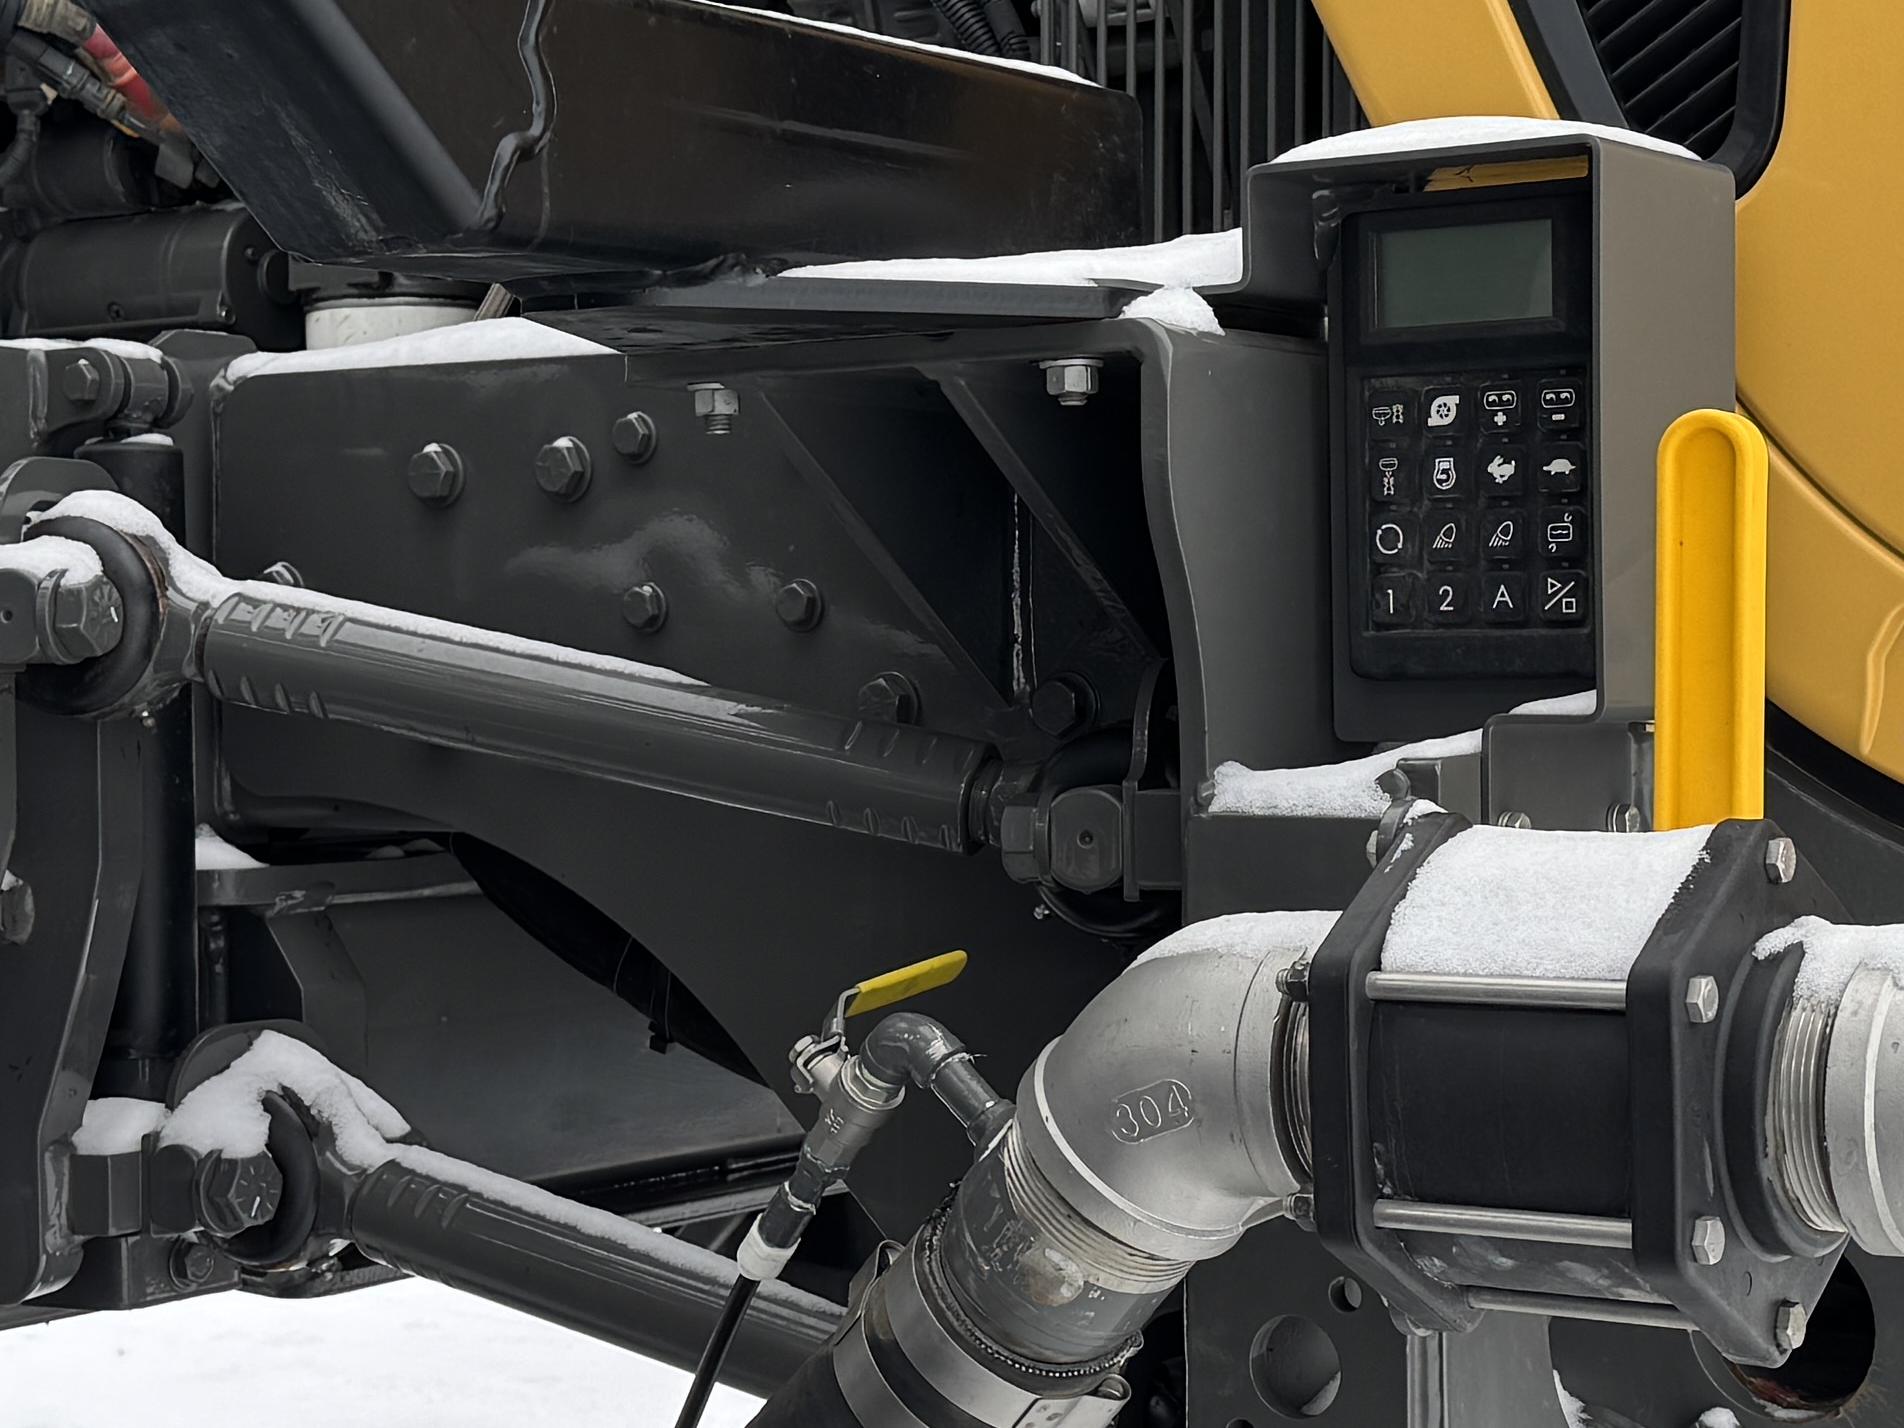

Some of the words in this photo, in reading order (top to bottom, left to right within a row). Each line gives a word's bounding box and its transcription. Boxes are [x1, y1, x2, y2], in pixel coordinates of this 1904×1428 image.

[1387, 588, 1394, 614] 1
[1438, 585, 1454, 611] 2
[1492, 584, 1514, 609] A
[1116, 1085, 1189, 1138] 304
